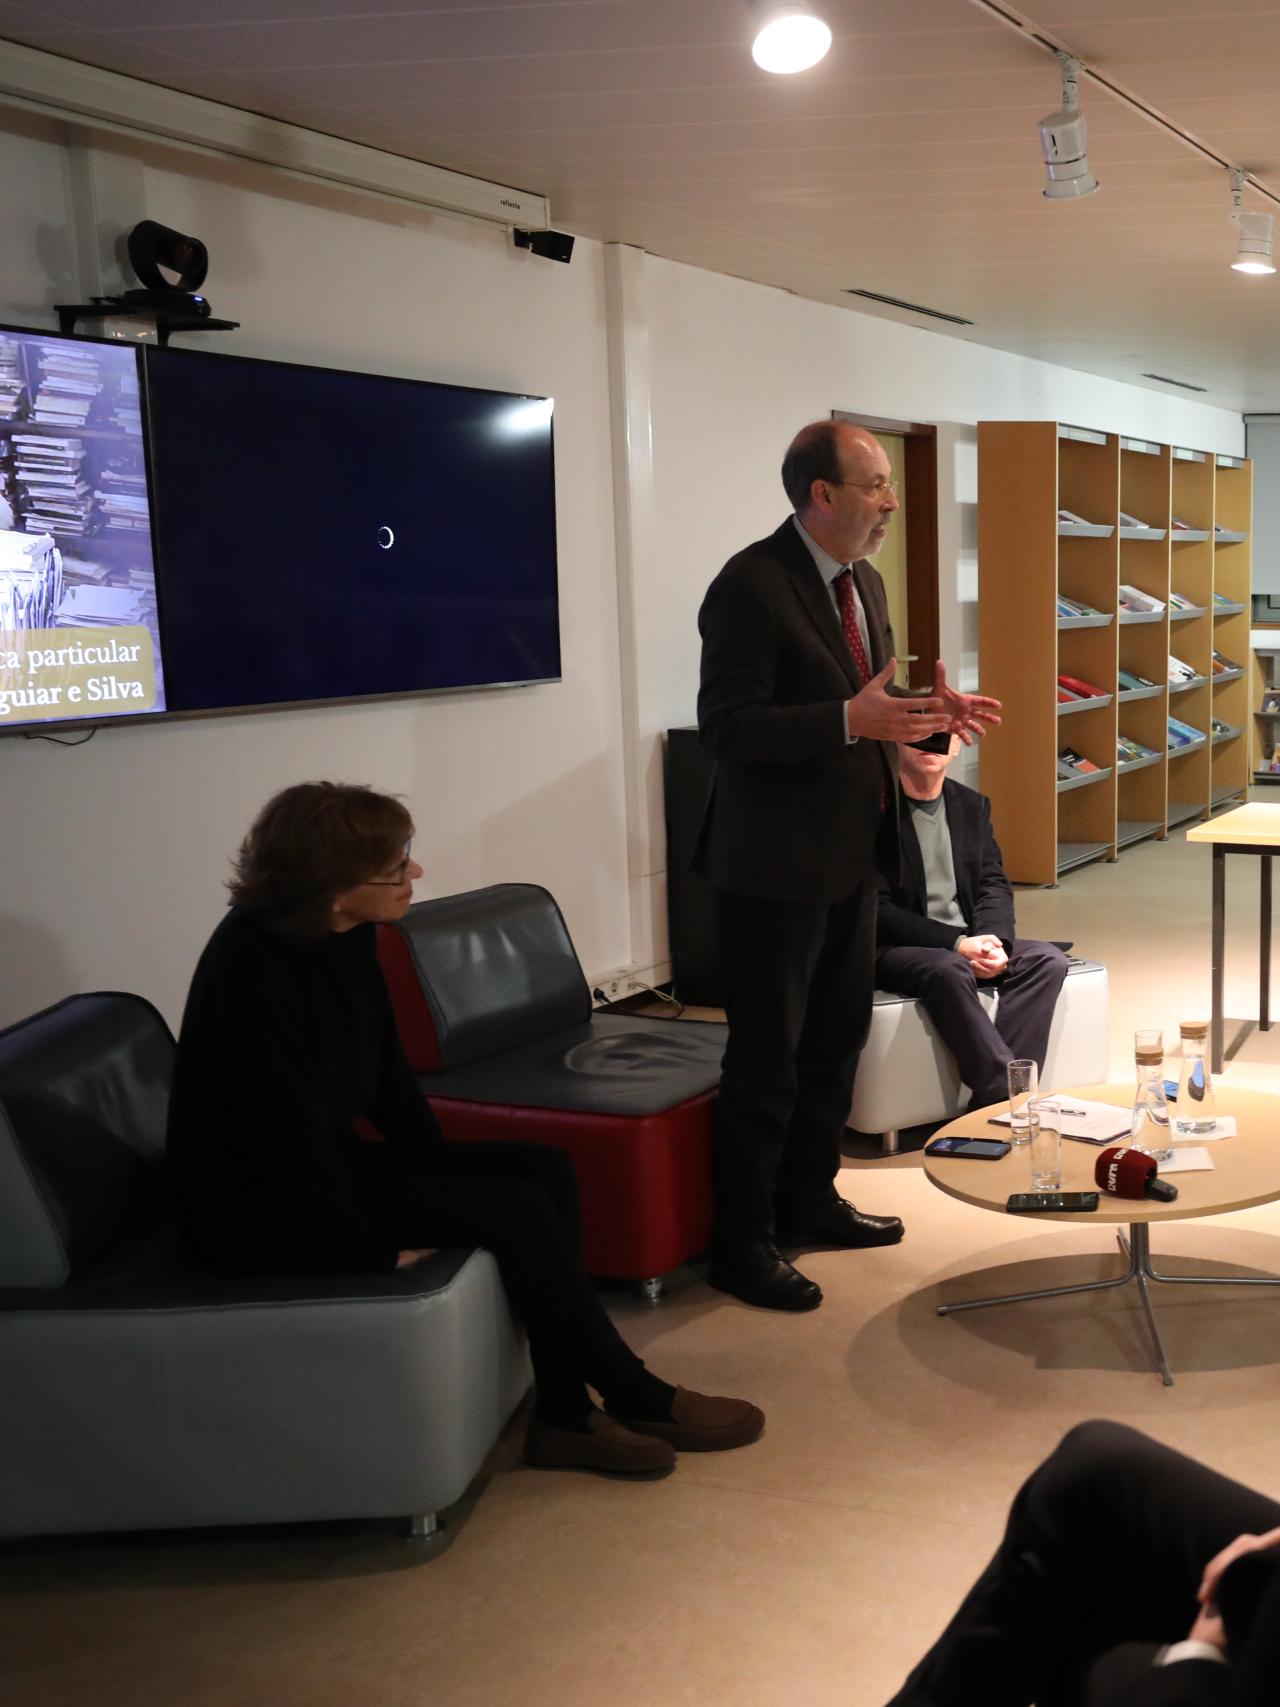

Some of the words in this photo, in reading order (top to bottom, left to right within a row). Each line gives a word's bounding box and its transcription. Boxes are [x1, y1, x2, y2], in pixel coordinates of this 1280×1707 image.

[27, 640, 141, 674] particular
[67, 685, 82, 702] e
[87, 676, 144, 701] Silva
